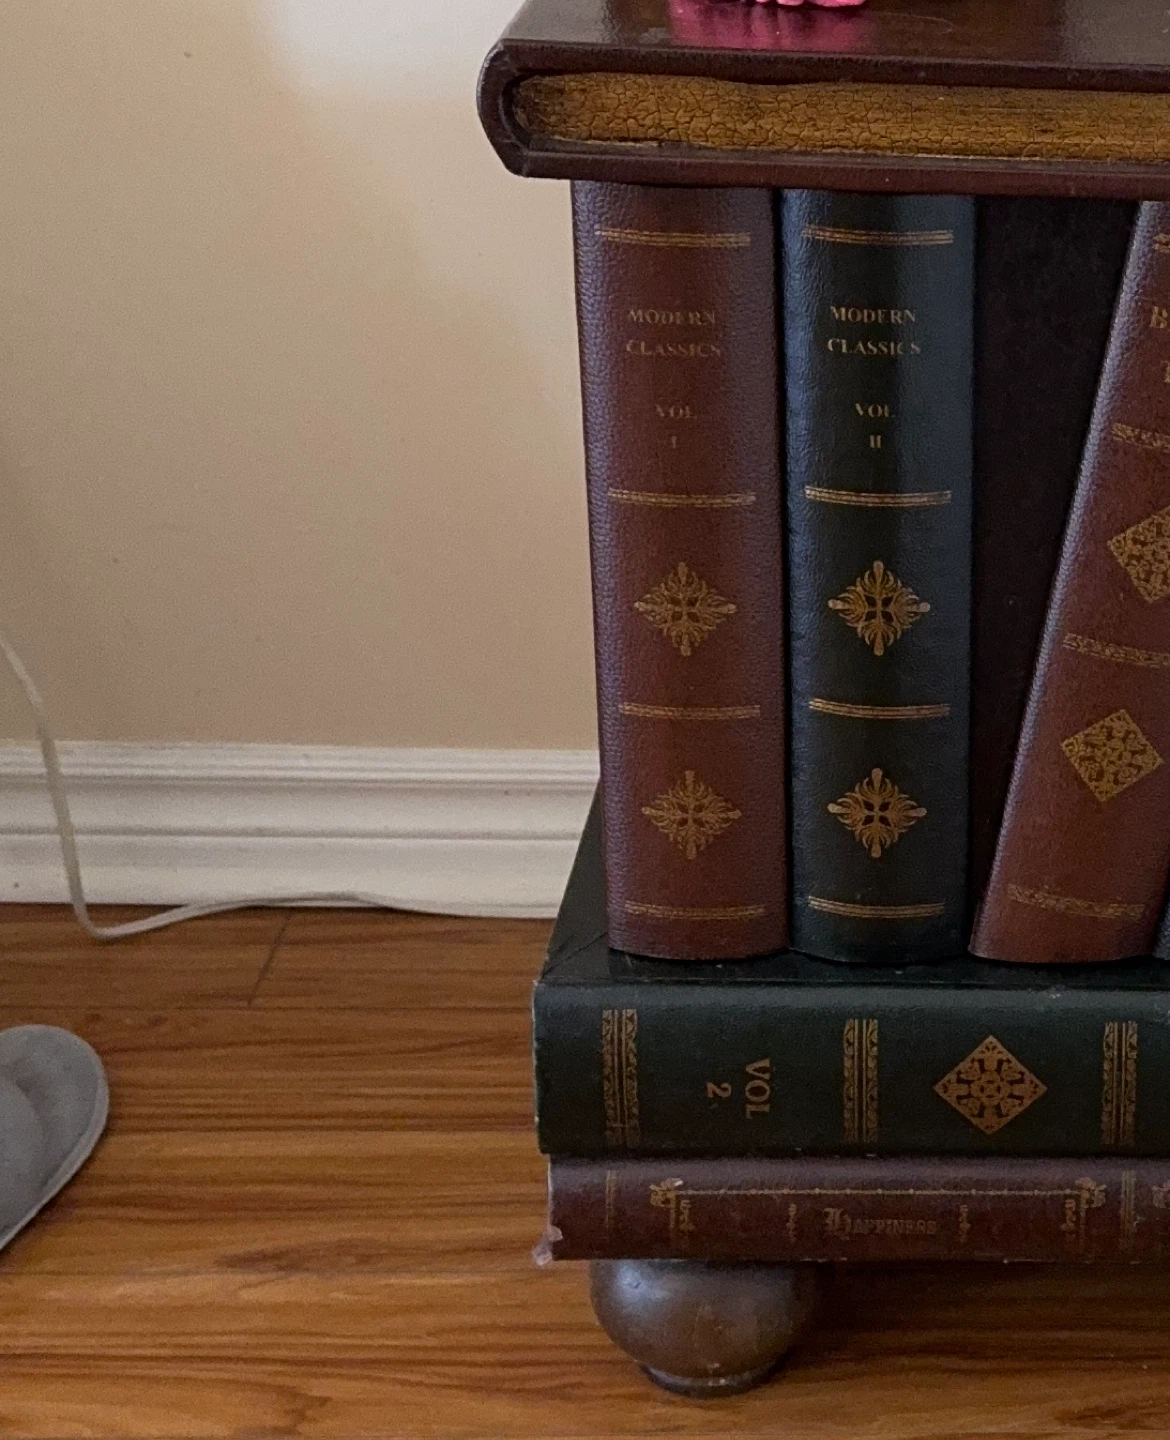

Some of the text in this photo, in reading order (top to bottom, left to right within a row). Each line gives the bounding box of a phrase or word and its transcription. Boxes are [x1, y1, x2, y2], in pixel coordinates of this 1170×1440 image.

[627, 308, 717, 326] MODERN
[829, 306, 917, 324] MODERN
[626, 339, 722, 358] CLASSICS
[827, 337, 922, 356] CLASSICS
[854, 403, 896, 420] VOL
[868, 434, 883, 450] II
[706, 1081, 732, 1098] 2
[745, 1058, 771, 1119] VOL
